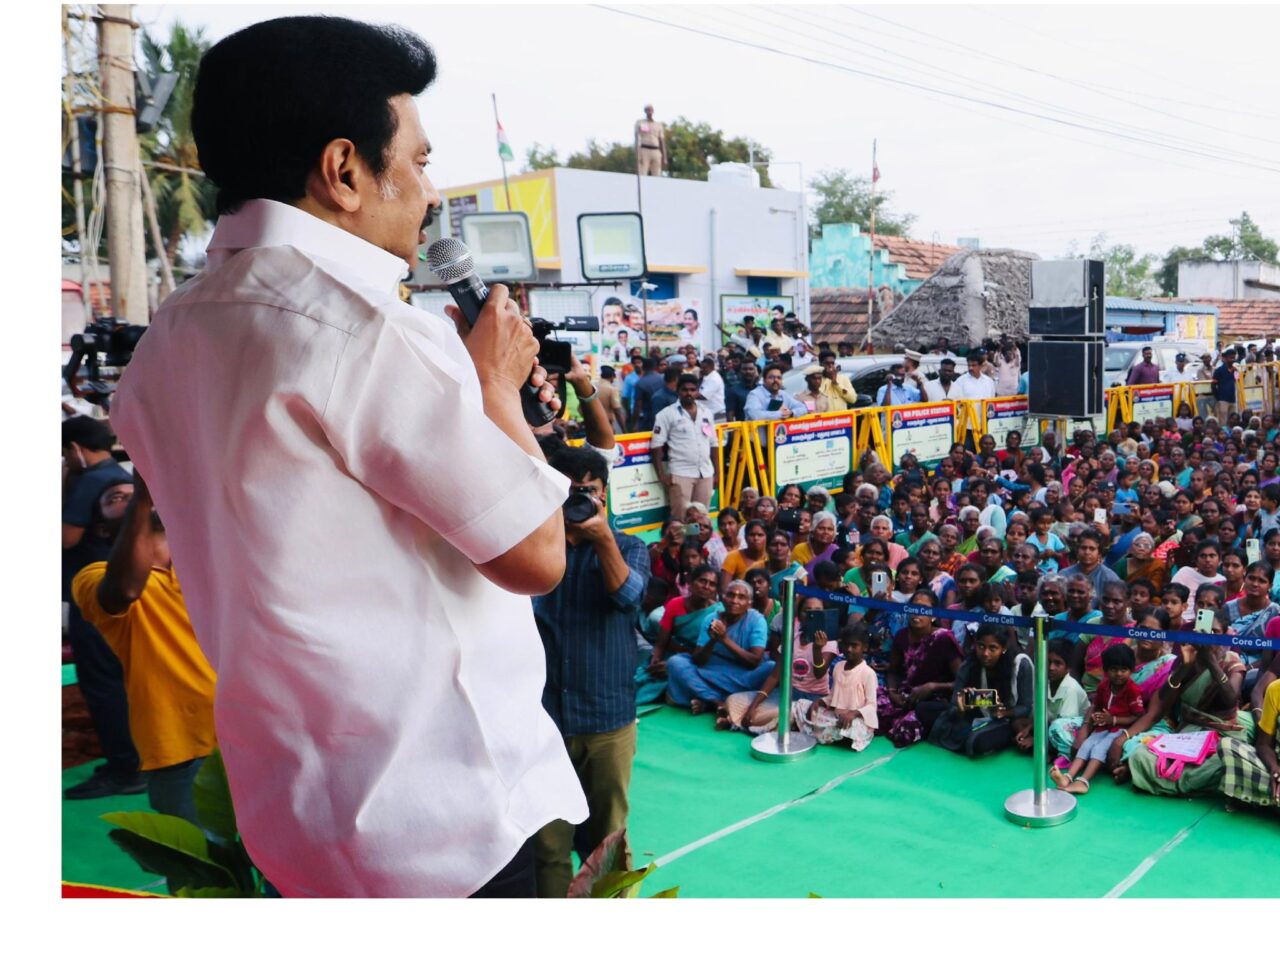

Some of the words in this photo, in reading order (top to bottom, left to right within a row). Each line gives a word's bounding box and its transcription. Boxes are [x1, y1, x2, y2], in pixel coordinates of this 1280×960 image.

[903, 605, 917, 614] Core
[919, 607, 933, 616] Cell
[983, 614, 998, 623] Core
[999, 616, 1014, 625] Cell
[1128, 629, 1148, 637] Core
[1150, 631, 1166, 639] Cell
[1232, 637, 1254, 646] Core
[1255, 639, 1272, 647] Cell
